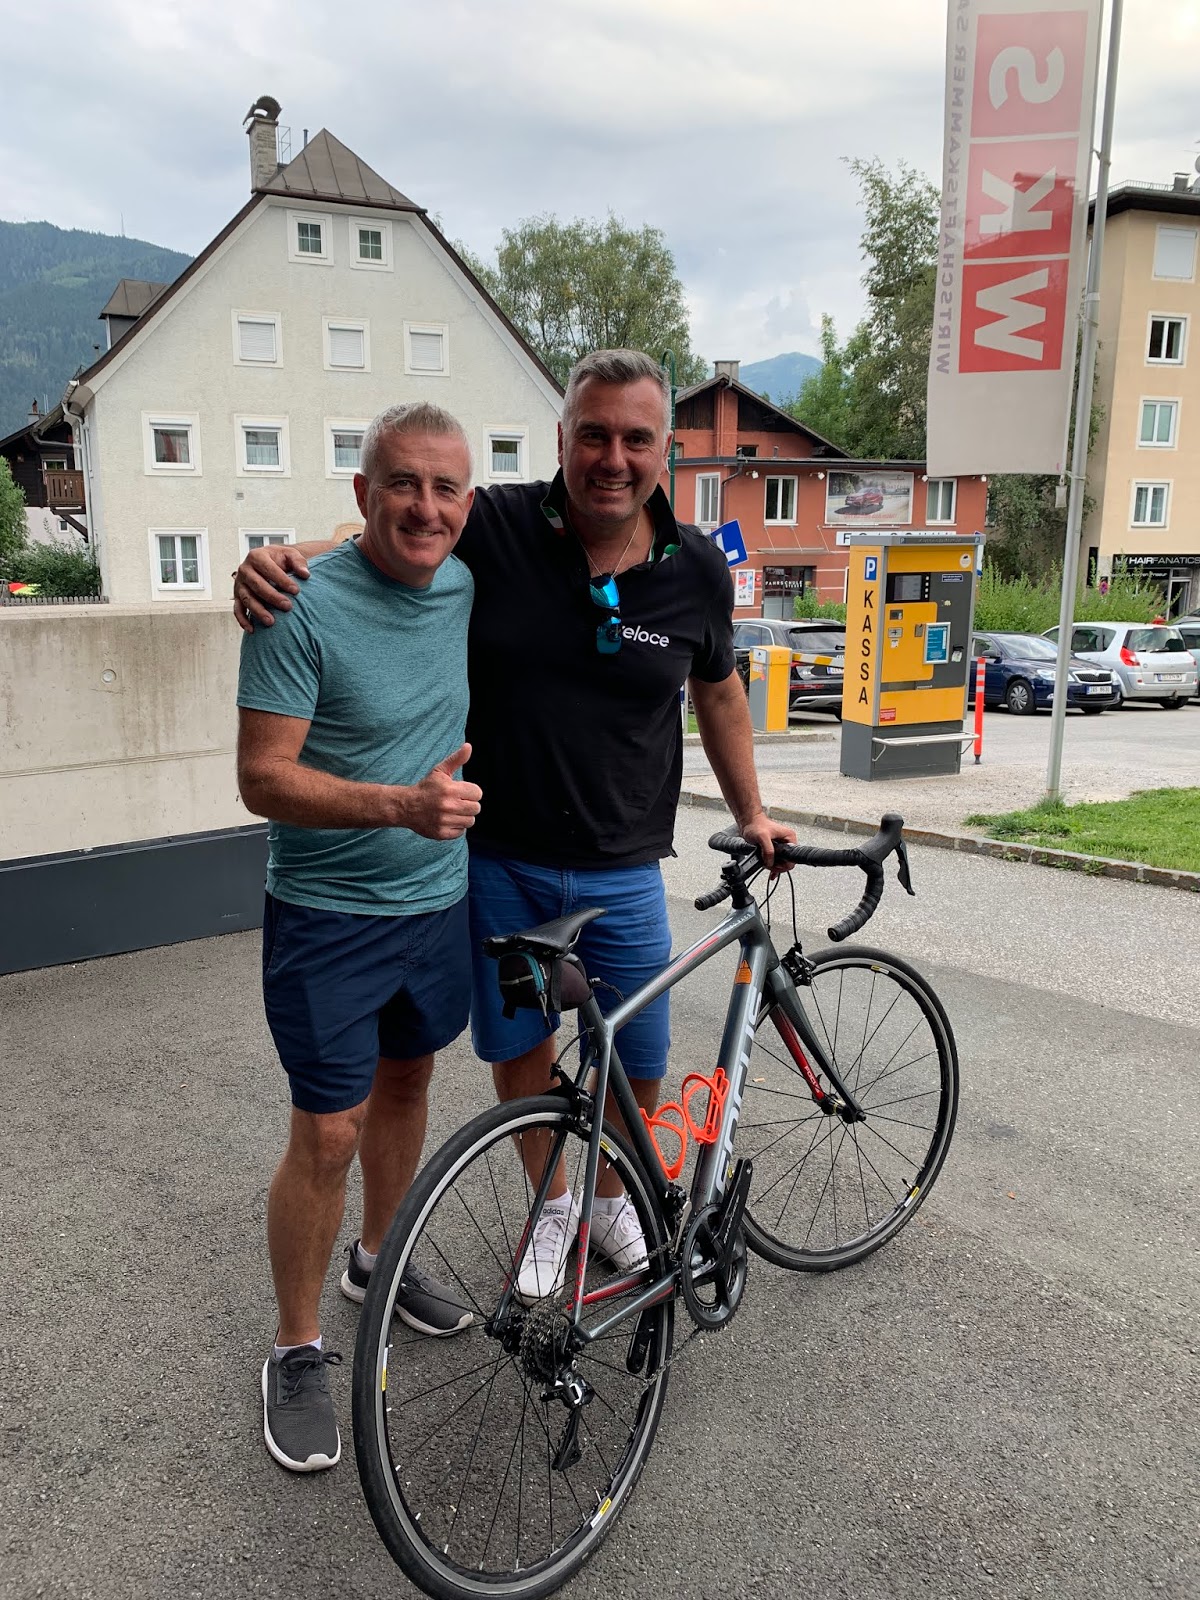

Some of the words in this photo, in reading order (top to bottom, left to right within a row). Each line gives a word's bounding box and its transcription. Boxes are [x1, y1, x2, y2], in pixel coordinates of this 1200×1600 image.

[622, 625, 670, 648] eloce
[858, 590, 874, 705] KASSA
[542, 1207, 565, 1216] adidas
